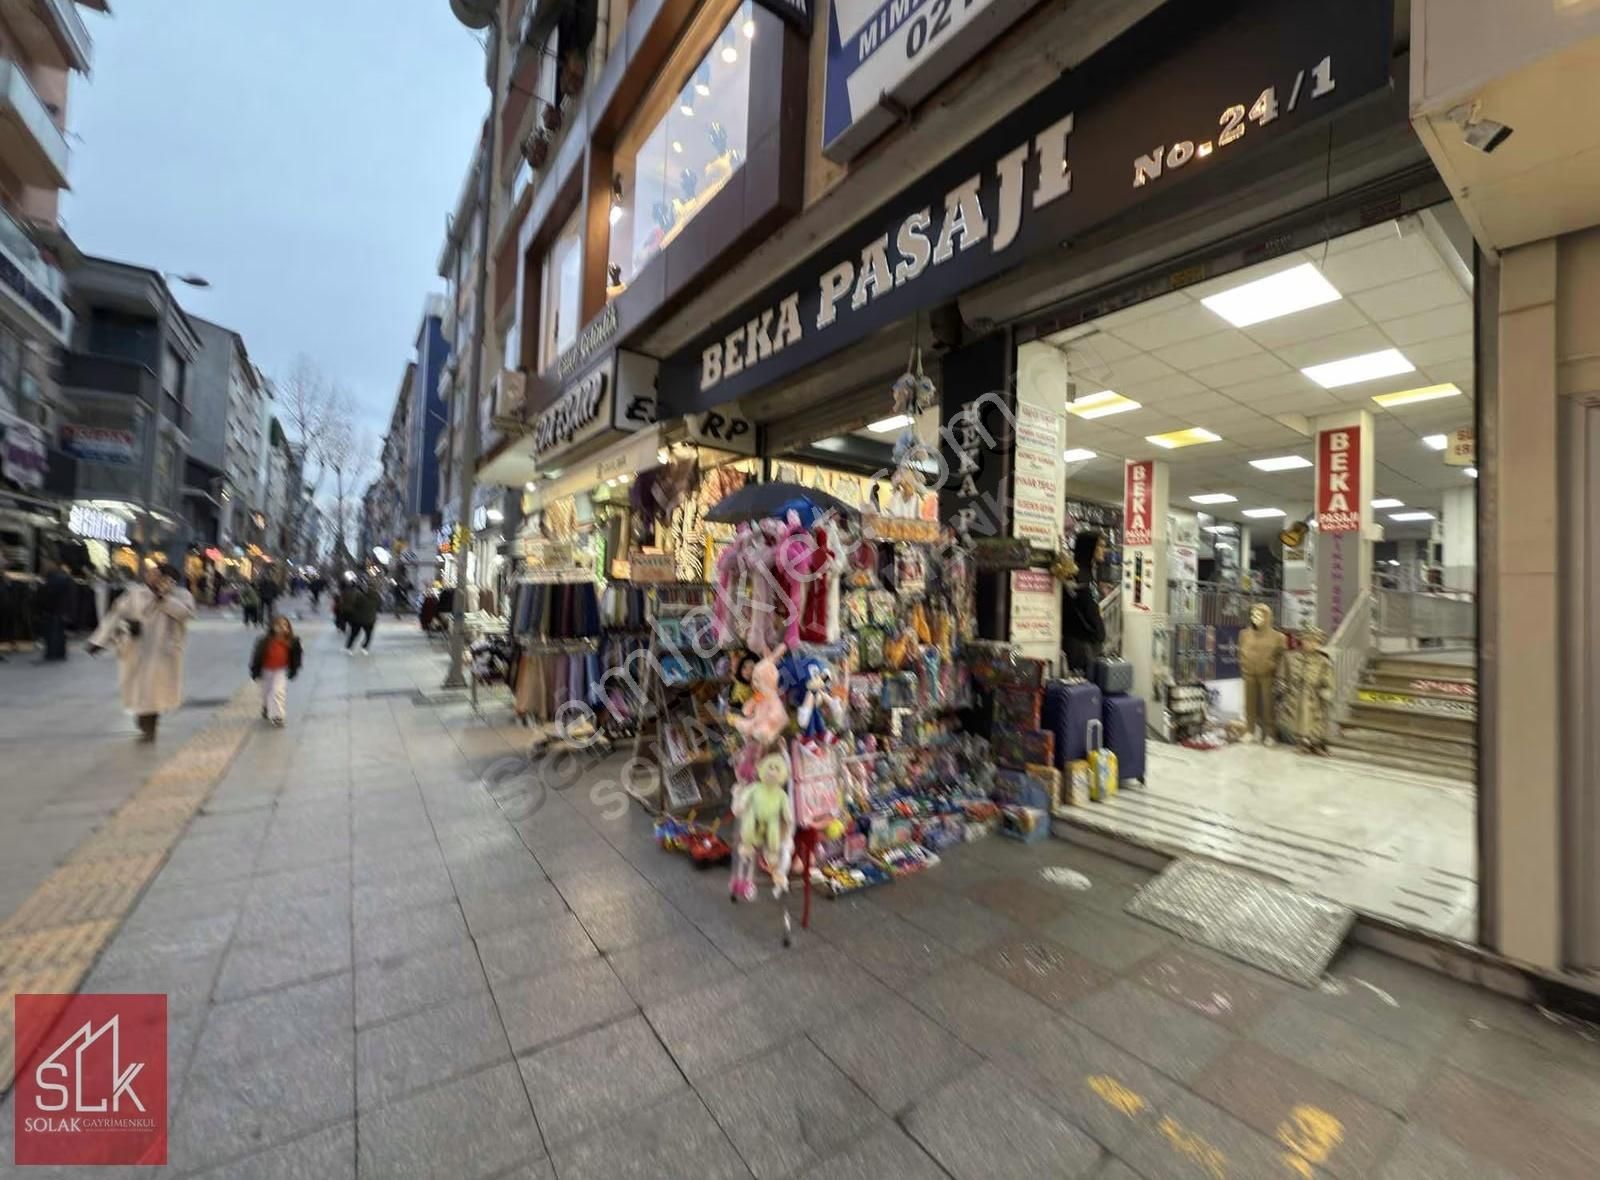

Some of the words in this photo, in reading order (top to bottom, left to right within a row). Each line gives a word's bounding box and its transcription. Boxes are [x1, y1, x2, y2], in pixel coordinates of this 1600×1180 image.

[701, 292, 802, 392] BEKA
[816, 112, 1074, 330] PASAJI
[1132, 465, 1147, 529] BEKA
[1328, 433, 1350, 512] BEKA
